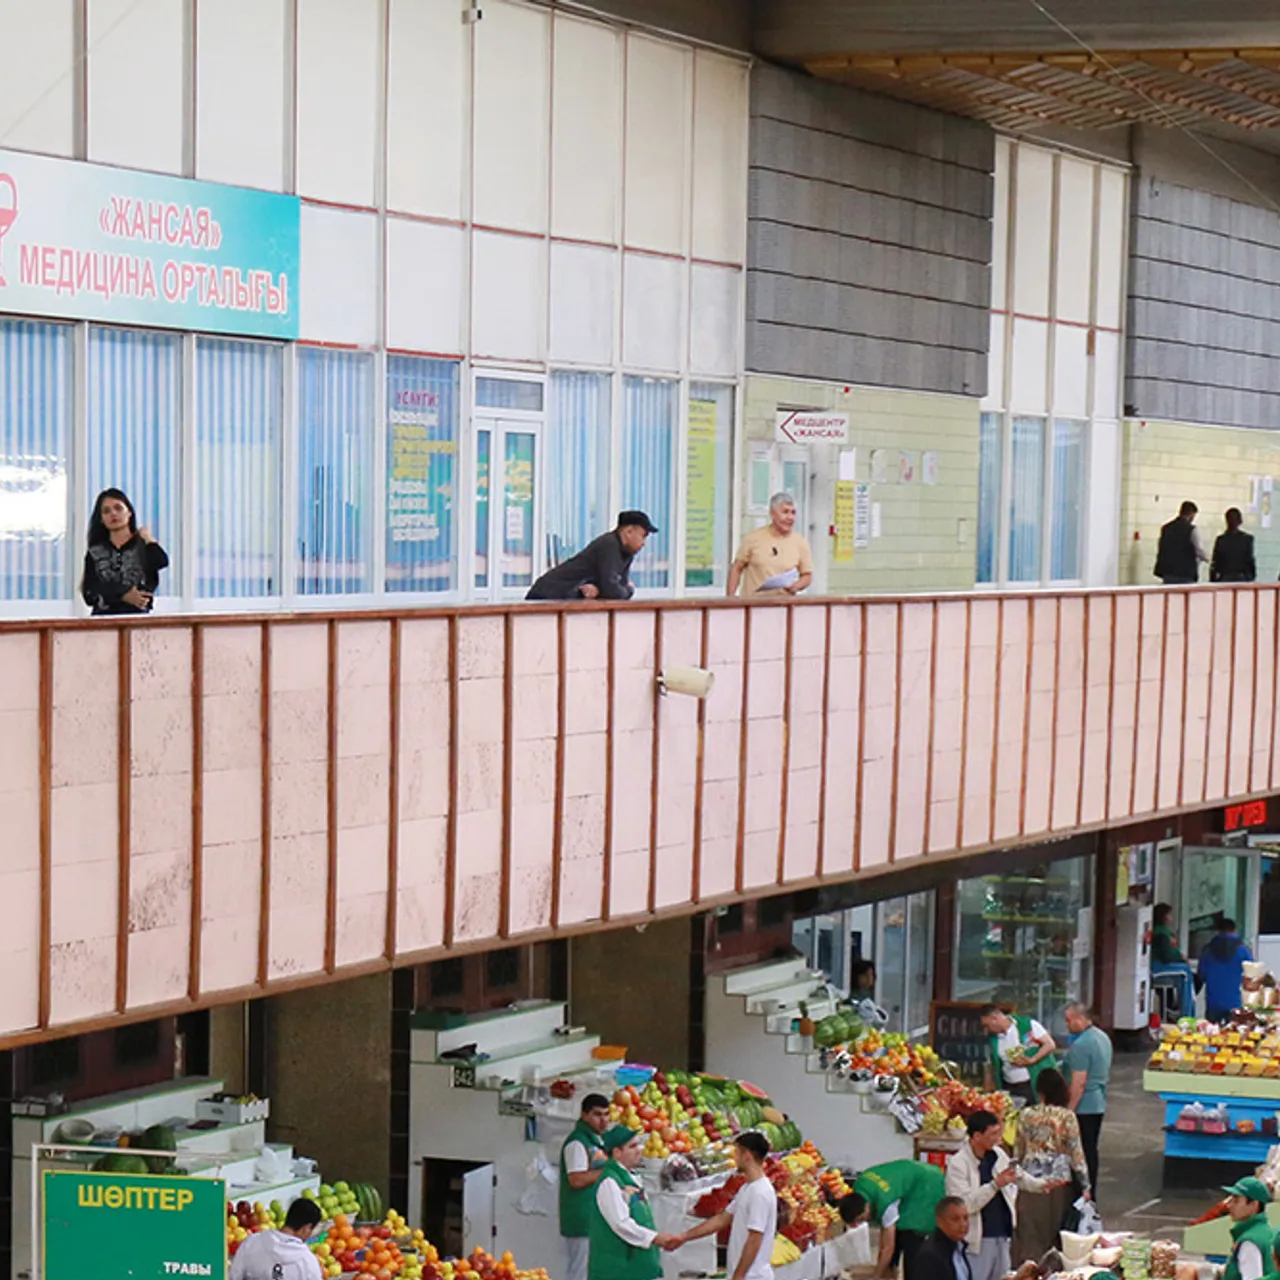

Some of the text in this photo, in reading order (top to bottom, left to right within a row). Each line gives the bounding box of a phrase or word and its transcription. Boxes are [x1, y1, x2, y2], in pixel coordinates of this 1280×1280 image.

[100, 197, 221, 247] «ЖАНСАЯ»
[20, 244, 287, 313] МЕДИЦИНА ОРТАЛЫҒЫ
[77, 1183, 194, 1212] ШӨПТЕР
[163, 1262, 211, 1276] ТРАВЫ
